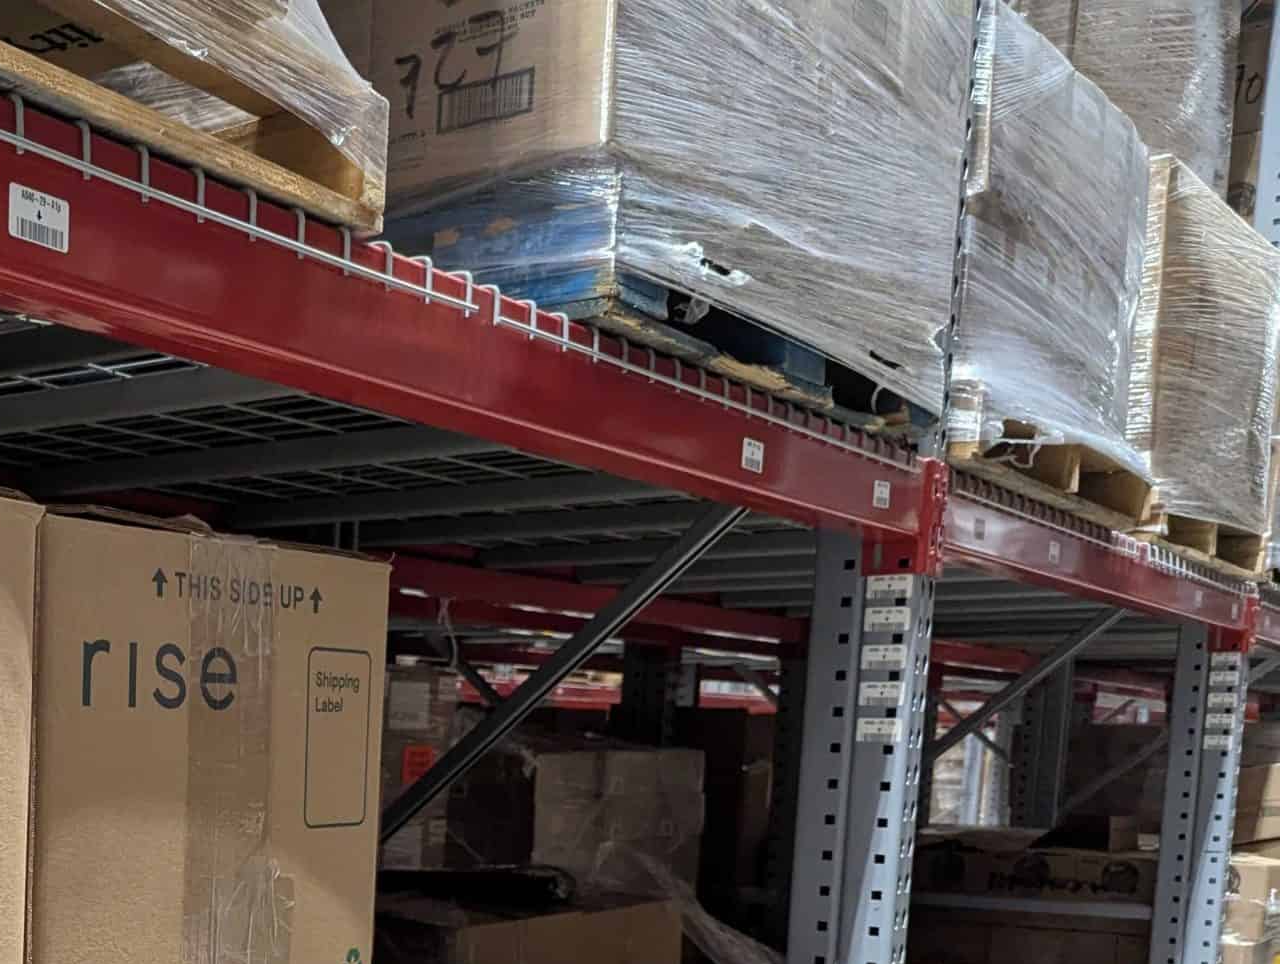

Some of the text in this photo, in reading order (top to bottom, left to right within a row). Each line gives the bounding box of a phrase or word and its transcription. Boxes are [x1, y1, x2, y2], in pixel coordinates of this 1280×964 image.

[174, 571, 305, 609] THIS SIDE UP
[81, 639, 238, 711] rise
[314, 671, 361, 692] Shipping
[314, 697, 344, 713] Label
